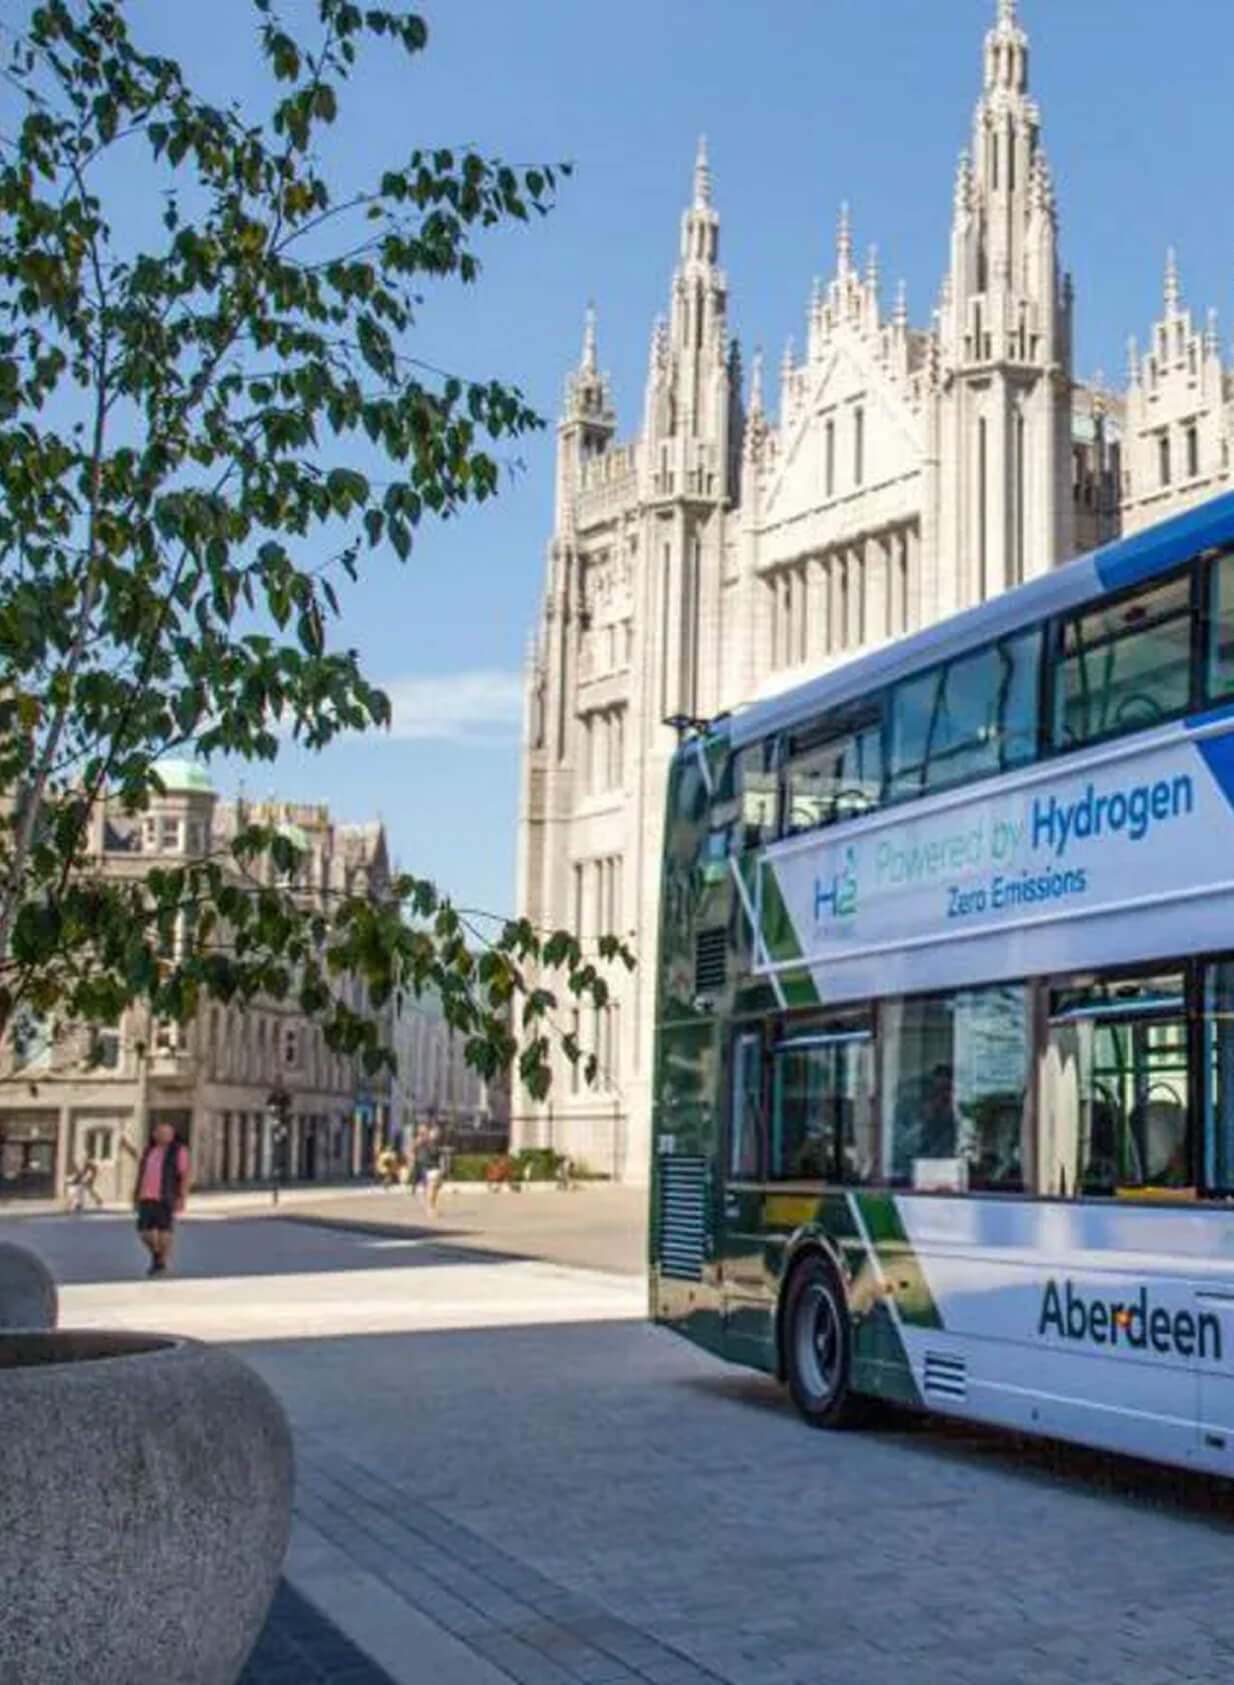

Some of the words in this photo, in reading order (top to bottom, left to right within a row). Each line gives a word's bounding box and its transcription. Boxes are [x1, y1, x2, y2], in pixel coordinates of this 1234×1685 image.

[877, 814, 982, 884] Powered
[991, 814, 1026, 868] by
[1032, 774, 1194, 857] Hydrogen
[947, 886, 987, 918] Zero
[991, 866, 1087, 909] Emissions
[1037, 1278, 1222, 1361] Aberdeen
